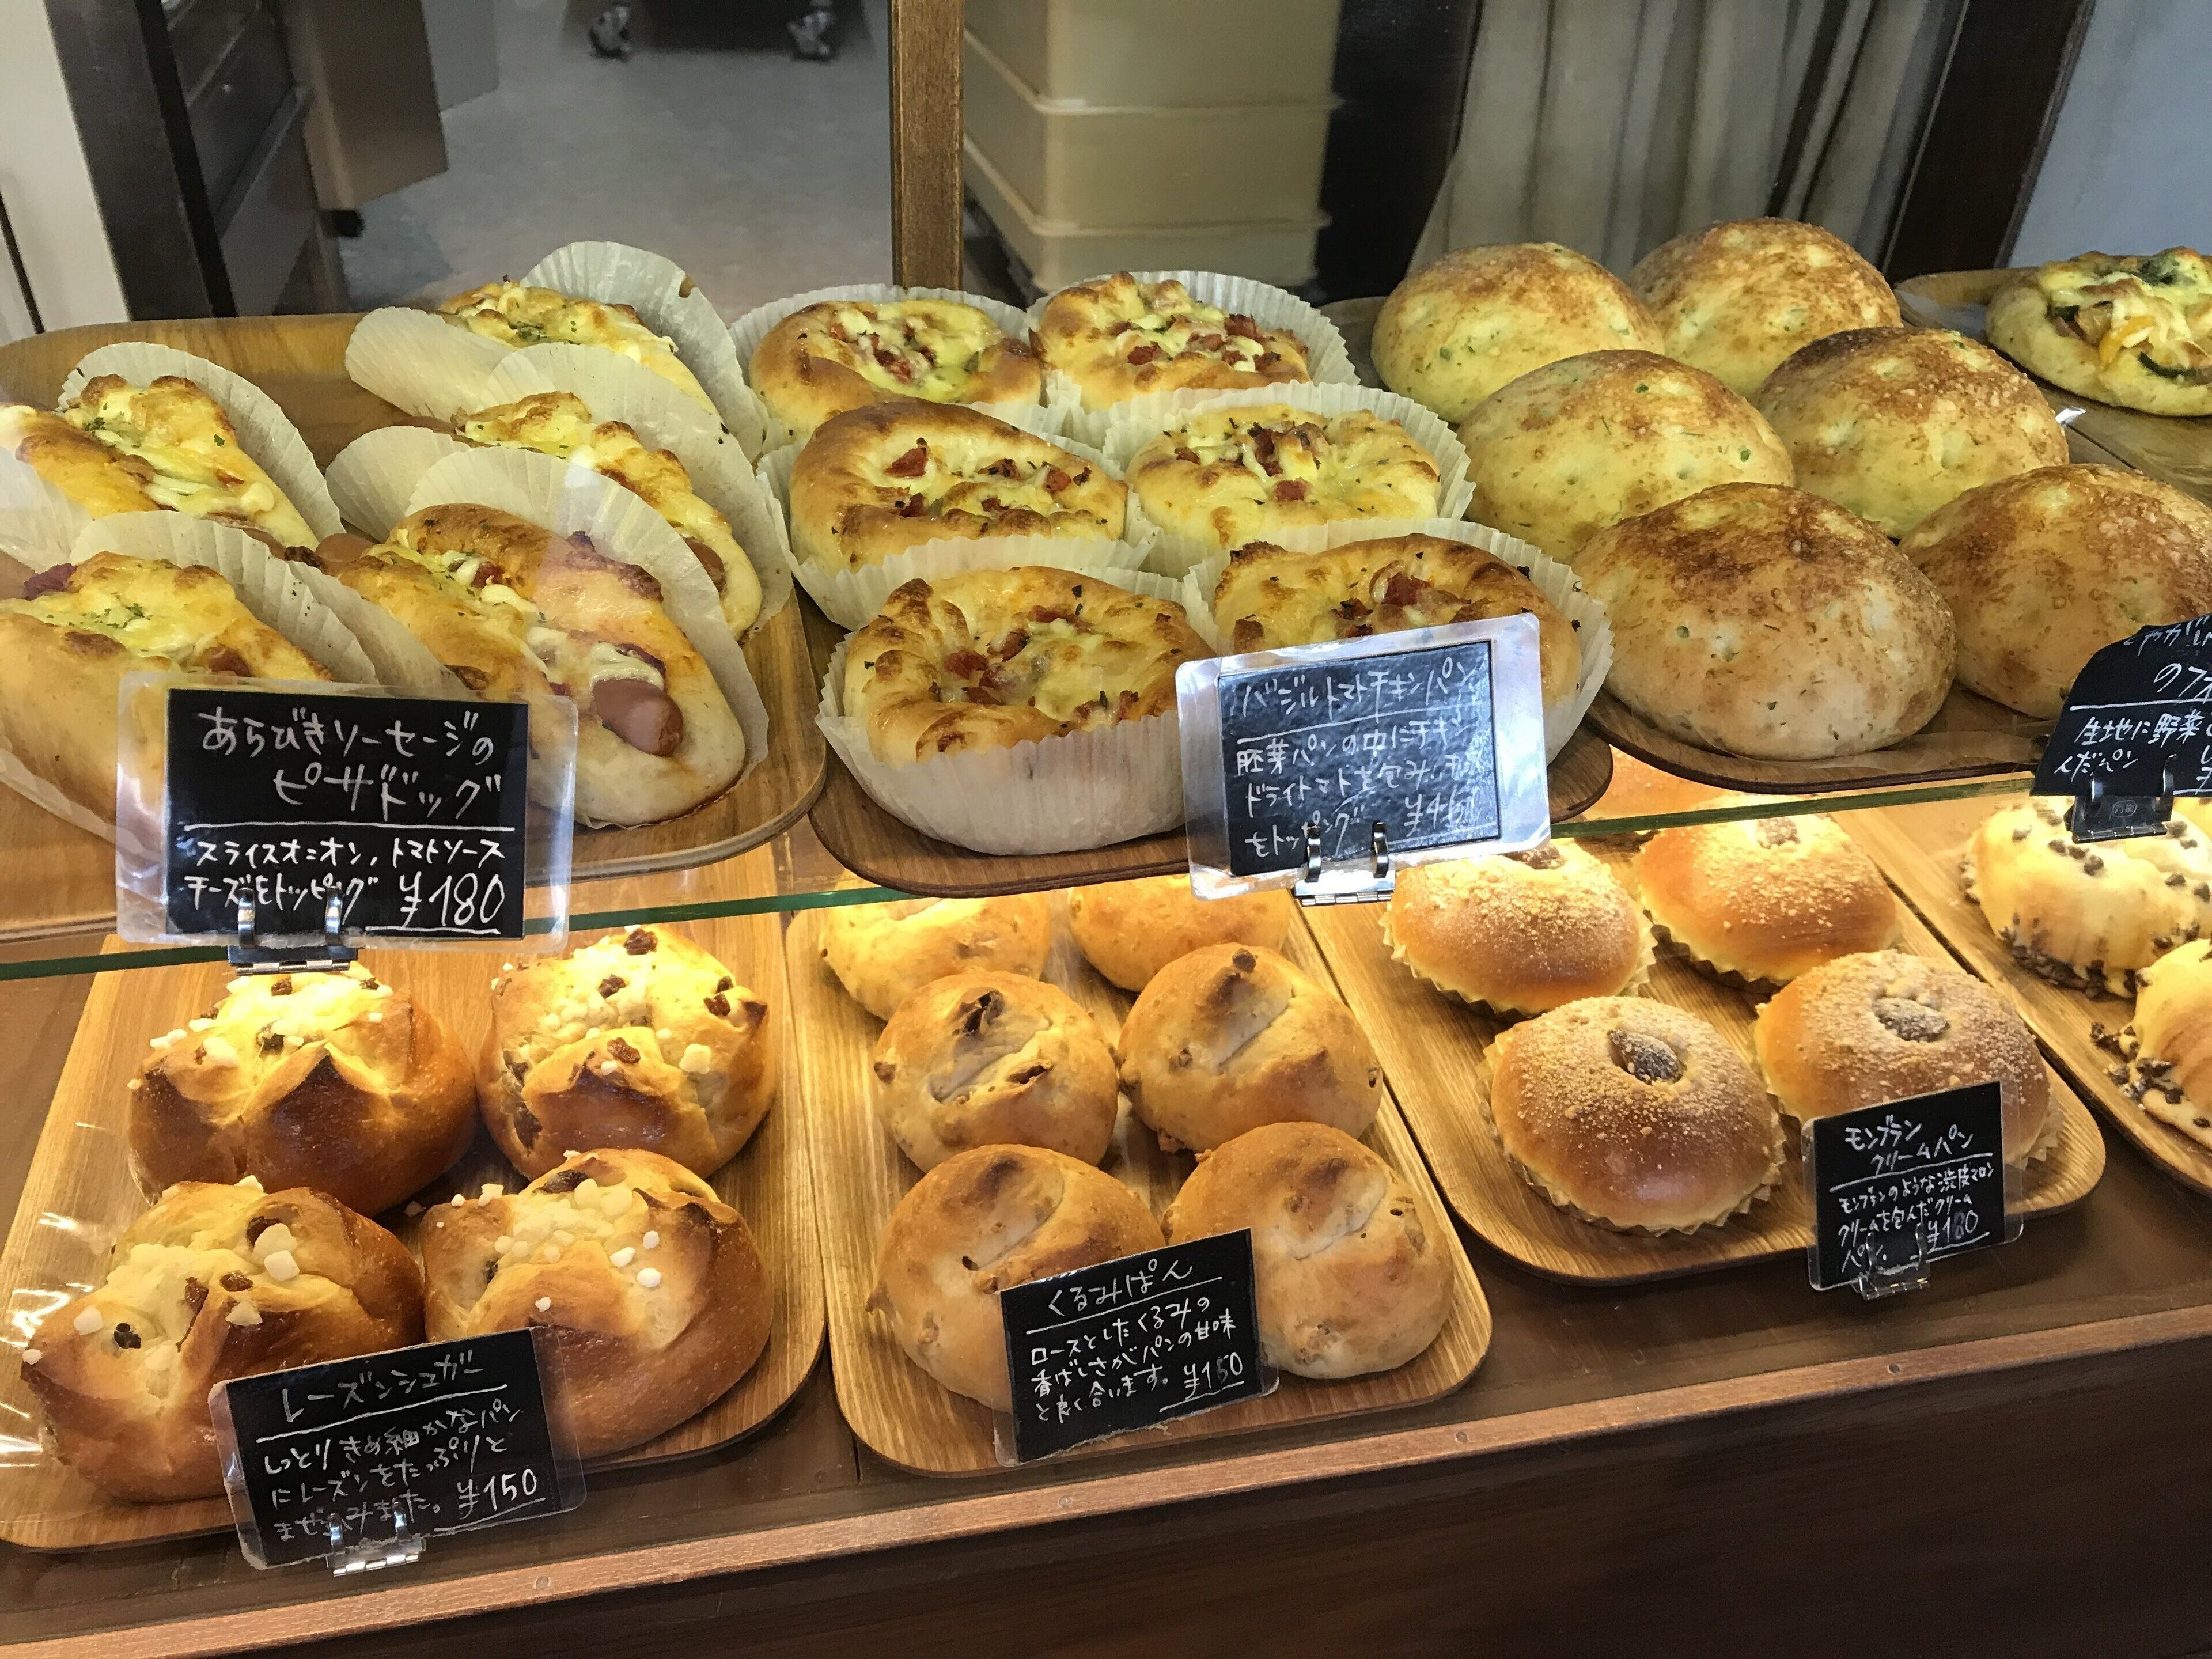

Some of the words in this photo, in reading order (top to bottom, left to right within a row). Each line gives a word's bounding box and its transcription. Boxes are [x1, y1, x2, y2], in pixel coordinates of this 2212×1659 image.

[1243, 657, 1476, 724] バジルトマトチキンパン
[193, 706, 494, 766] あらびきソーセージの
[2074, 709, 2212, 748] 生地に野菜
[275, 763, 502, 821] ピザドッグ
[184, 873, 378, 925] チーズをトッピグ
[1844, 1115, 1922, 1150] モンブラン
[1870, 1124, 1974, 1176] クリームパン
[1048, 1259, 1193, 1316] くるみぱん
[1031, 1308, 1236, 1397] 香ばしさがパンの甘味
[282, 1350, 483, 1422] レーズンシュガー
[272, 1435, 508, 1510] にレーズンをたっぷりと
[274, 1488, 441, 1541] まぜみまた。
